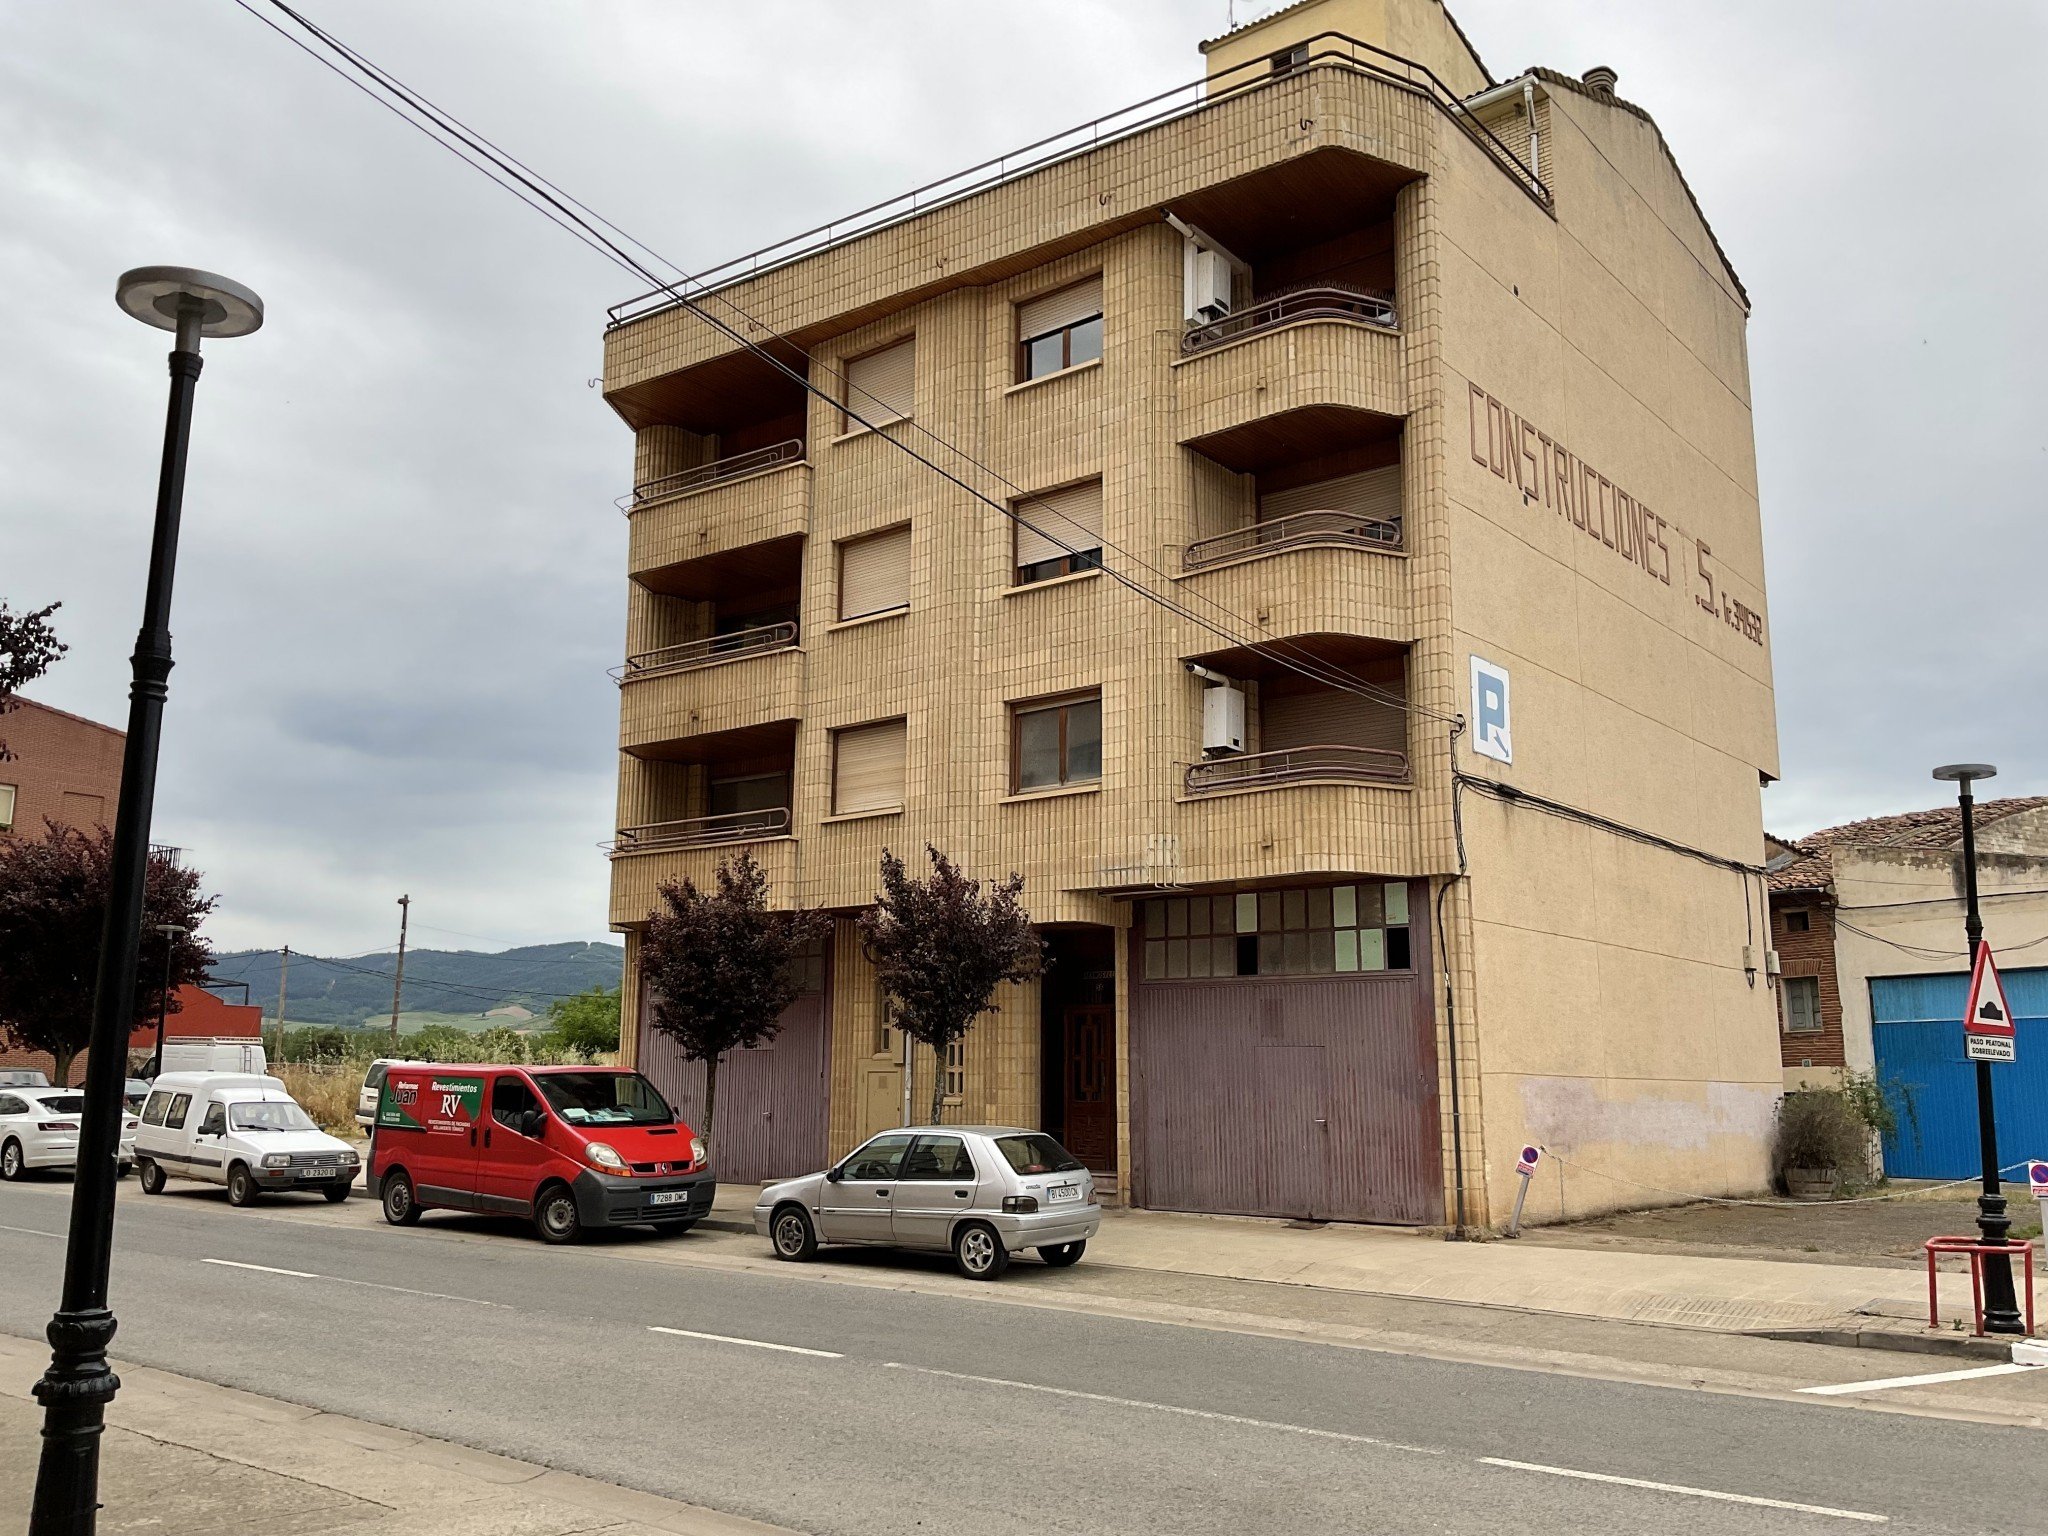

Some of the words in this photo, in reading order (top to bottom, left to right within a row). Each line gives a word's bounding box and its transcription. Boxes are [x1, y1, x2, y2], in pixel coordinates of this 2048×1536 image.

[1469, 381, 1670, 586] CONSTRUCCIONES
[1478, 671, 1504, 742] P
[1985, 1039, 2011, 1048] PEATONAL
[1972, 1047, 2010, 1057] SOBREELEVADO
[389, 1085, 417, 1105] Juan
[431, 1082, 477, 1093] Revestimientos
[440, 1095, 462, 1117] RV
[656, 1193, 673, 1203] 7288
